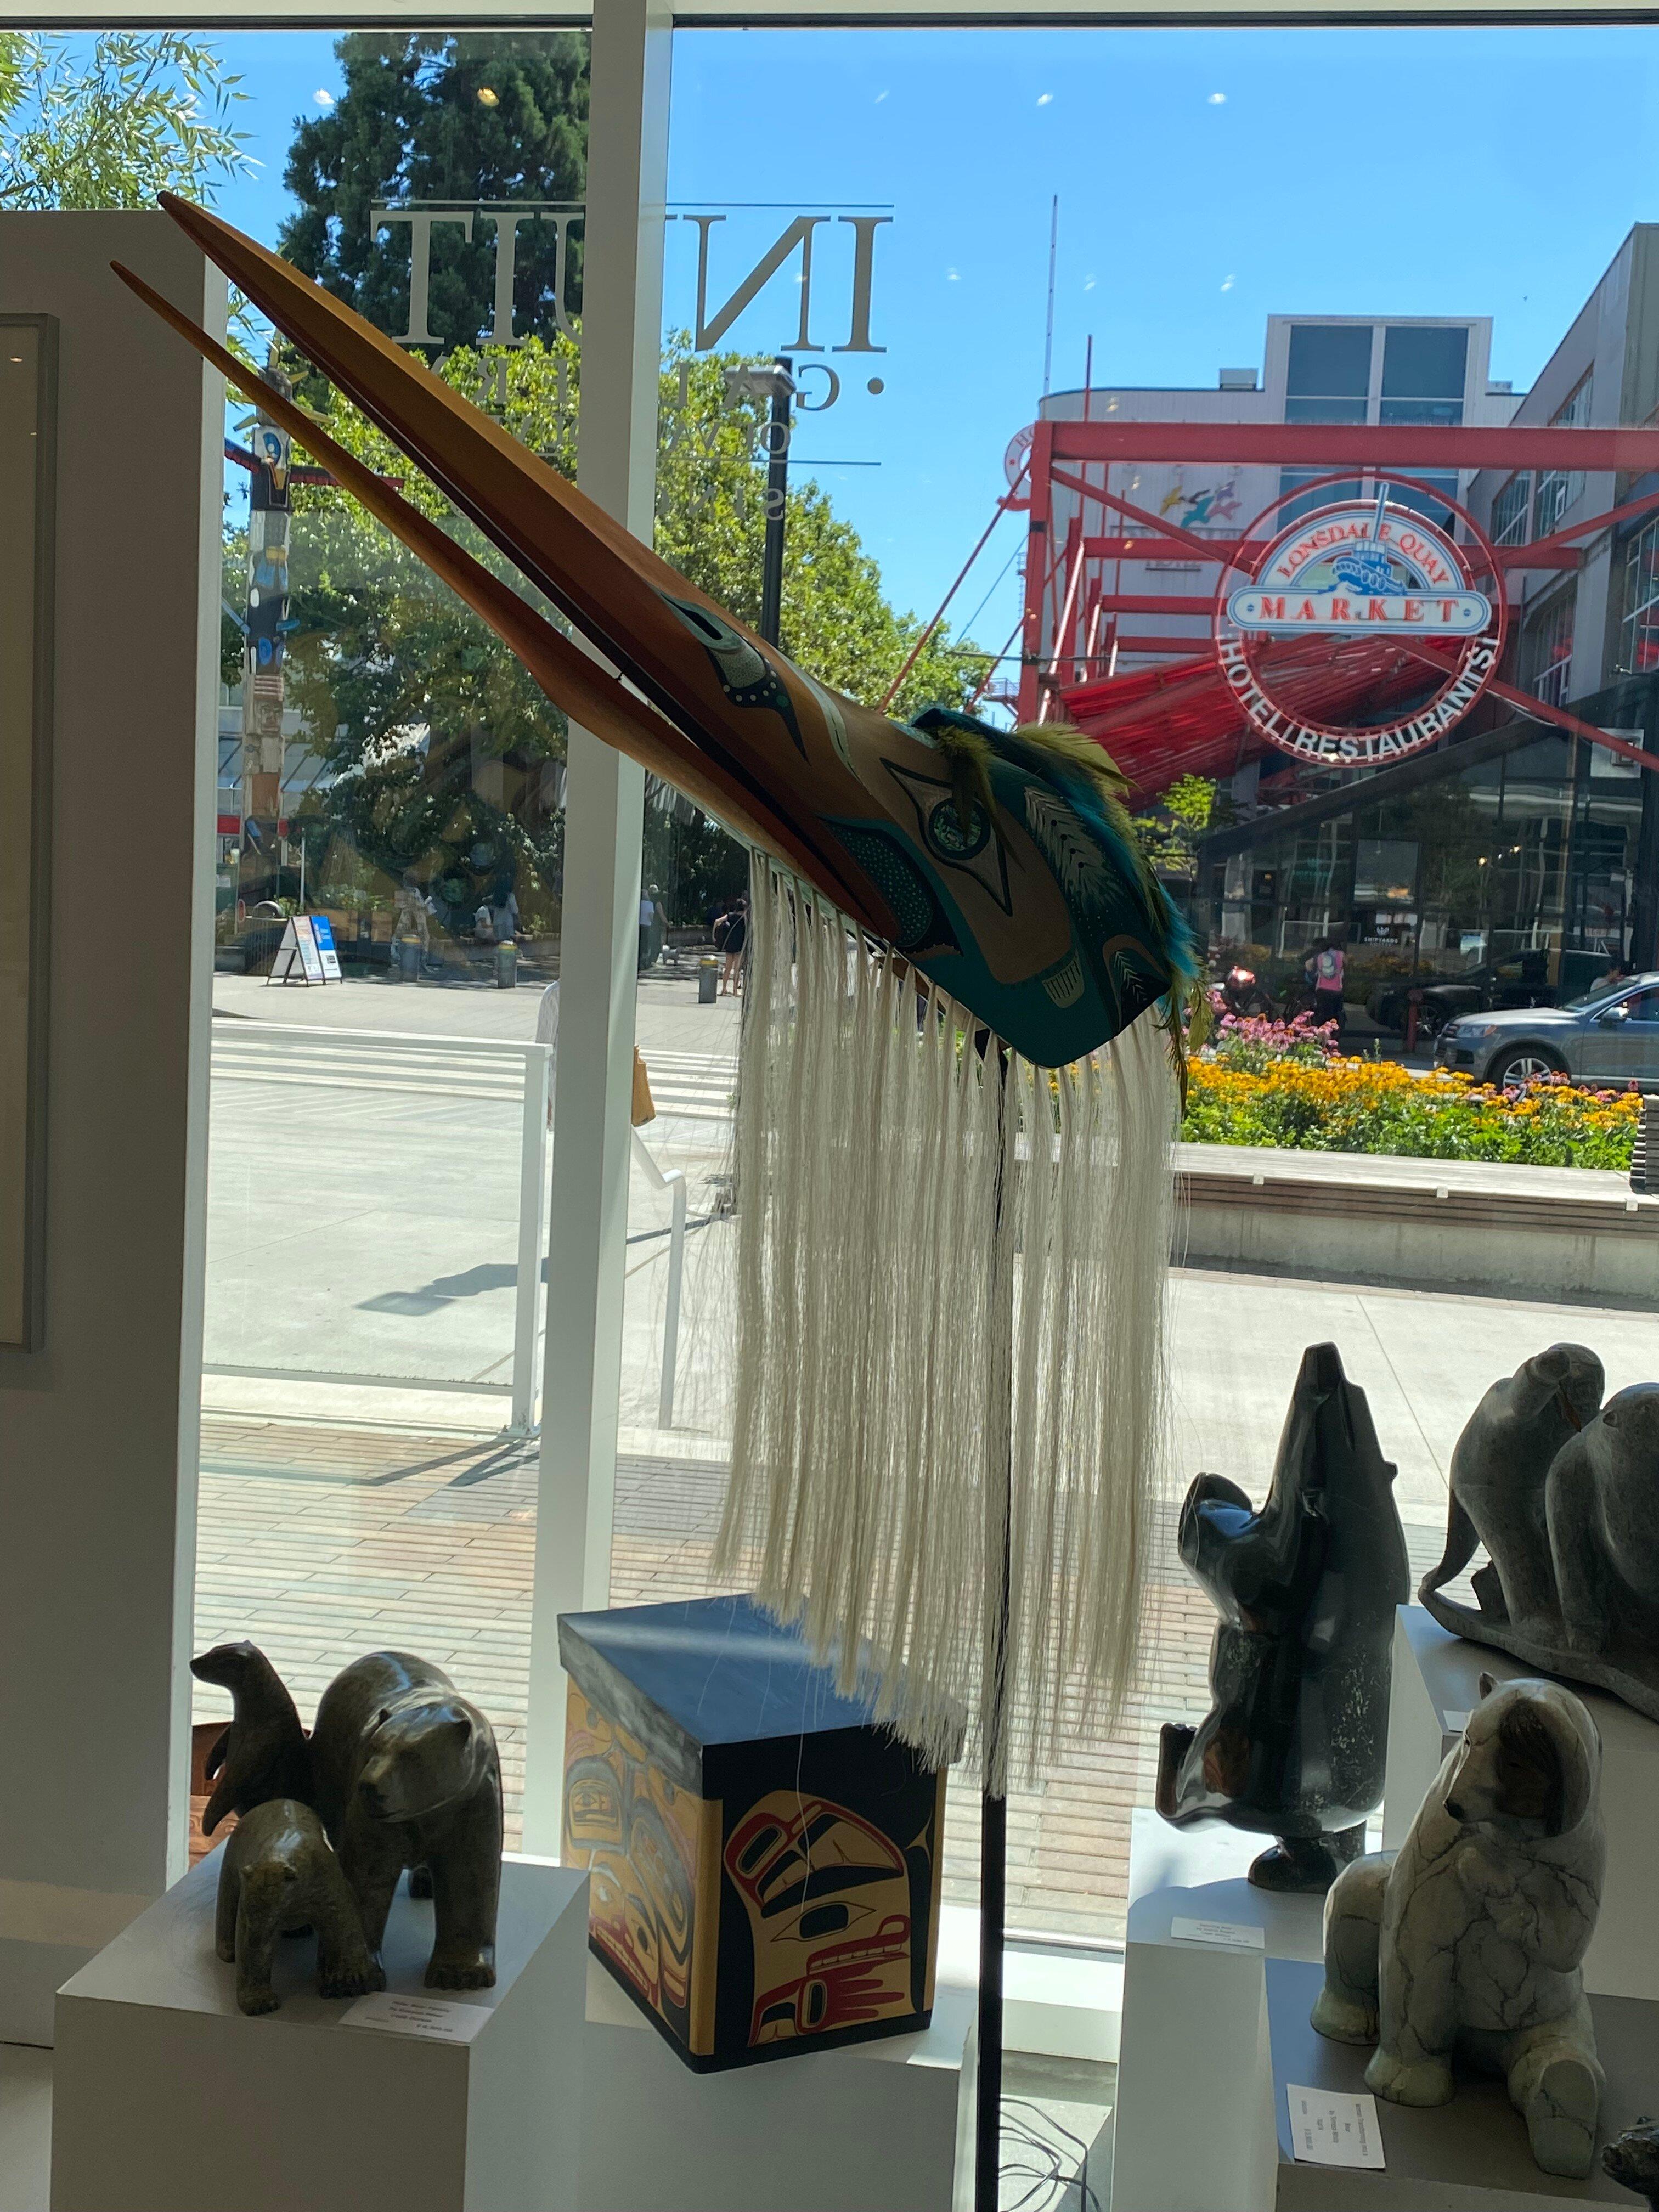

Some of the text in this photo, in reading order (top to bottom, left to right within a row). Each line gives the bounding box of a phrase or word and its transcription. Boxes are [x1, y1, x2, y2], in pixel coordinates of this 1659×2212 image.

[1277, 522, 1450, 584] LONSDALE QUAY
[1259, 597, 1460, 623] MARKET
[1218, 641, 1283, 738] HOTEL
